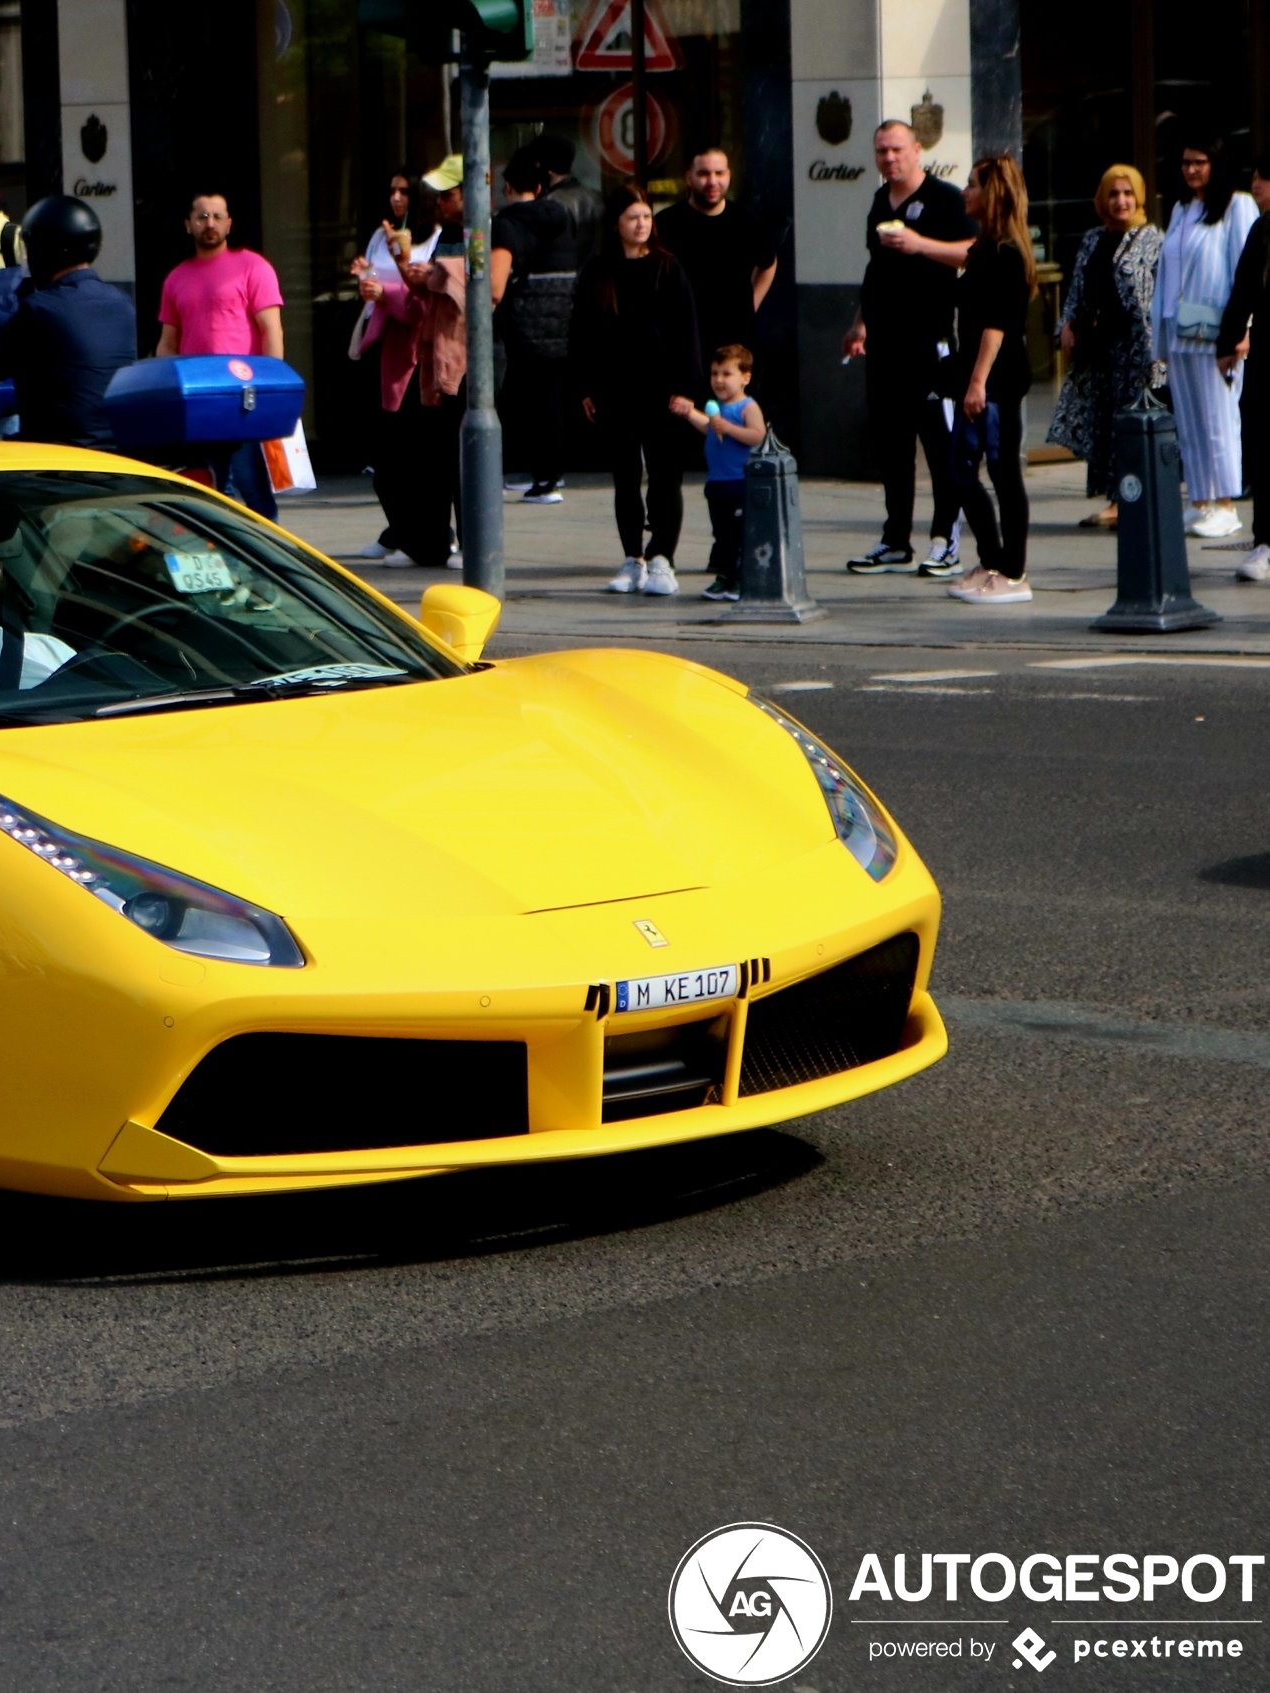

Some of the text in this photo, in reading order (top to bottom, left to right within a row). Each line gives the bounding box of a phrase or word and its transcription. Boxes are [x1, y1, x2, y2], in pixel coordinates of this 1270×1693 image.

[809, 160, 865, 181] Cartier
[74, 178, 116, 196] Cartier
[637, 970, 729, 1006] M KE 107
[619, 1000, 627, 1008] D
